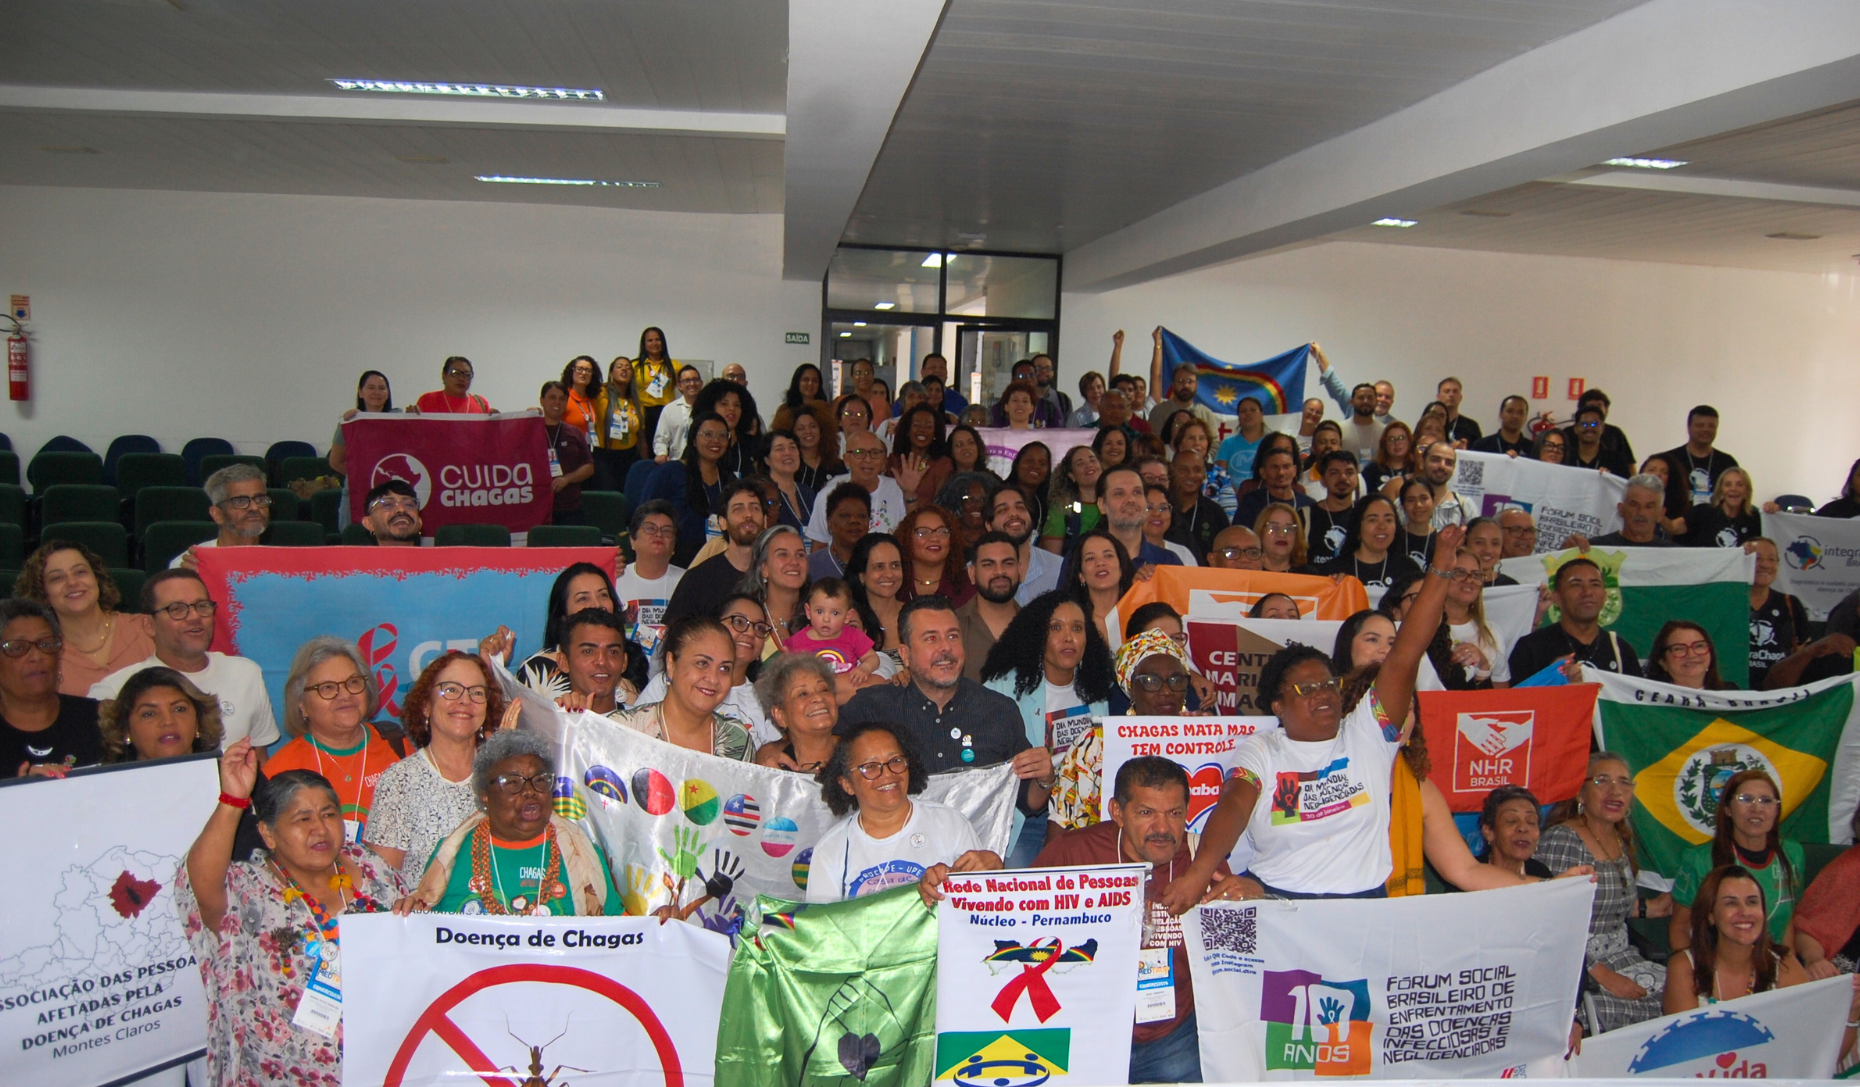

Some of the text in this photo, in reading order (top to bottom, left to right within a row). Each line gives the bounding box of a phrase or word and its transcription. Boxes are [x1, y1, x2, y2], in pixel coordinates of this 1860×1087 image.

[786, 333, 809, 343] SAÍDA
[1117, 723, 1256, 738] CHAGAS MATA MAS
[1131, 743, 1161, 756] TEM
[1470, 758, 1514, 776] NHR
[1190, 783, 1220, 796] aba
[1470, 775, 1511, 787] BRASIL
[906, 865, 923, 877] UPE
[943, 874, 1140, 893] Rede Nacional de Pessoas
[951, 891, 1131, 911] Vivendo com HIV e AIDS
[969, 914, 1017, 927] Núcleo
[1031, 912, 1112, 927] Pernambuco
[435, 927, 644, 950] Doença de Chagas
[101, 970, 133, 989] DAS
[137, 955, 198, 979] PESSOA
[1459, 965, 1517, 985] SOCIAL
[37, 983, 164, 1025] AFETADAS PELA
[1386, 980, 1515, 1010] BRASILEIRO DE
[1389, 996, 1513, 1025] ENFRENTAMENTO
[22, 996, 183, 1050] DOENÇA DE CHAGAS
[1386, 1024, 1424, 1040] DAS
[52, 1019, 162, 1059] Montes Claros
[1383, 1025, 1510, 1050] INFECCIOSAS E
[1283, 1043, 1350, 1064] ANOS
[1383, 1036, 1507, 1065] NEGLIGENCIADAS
